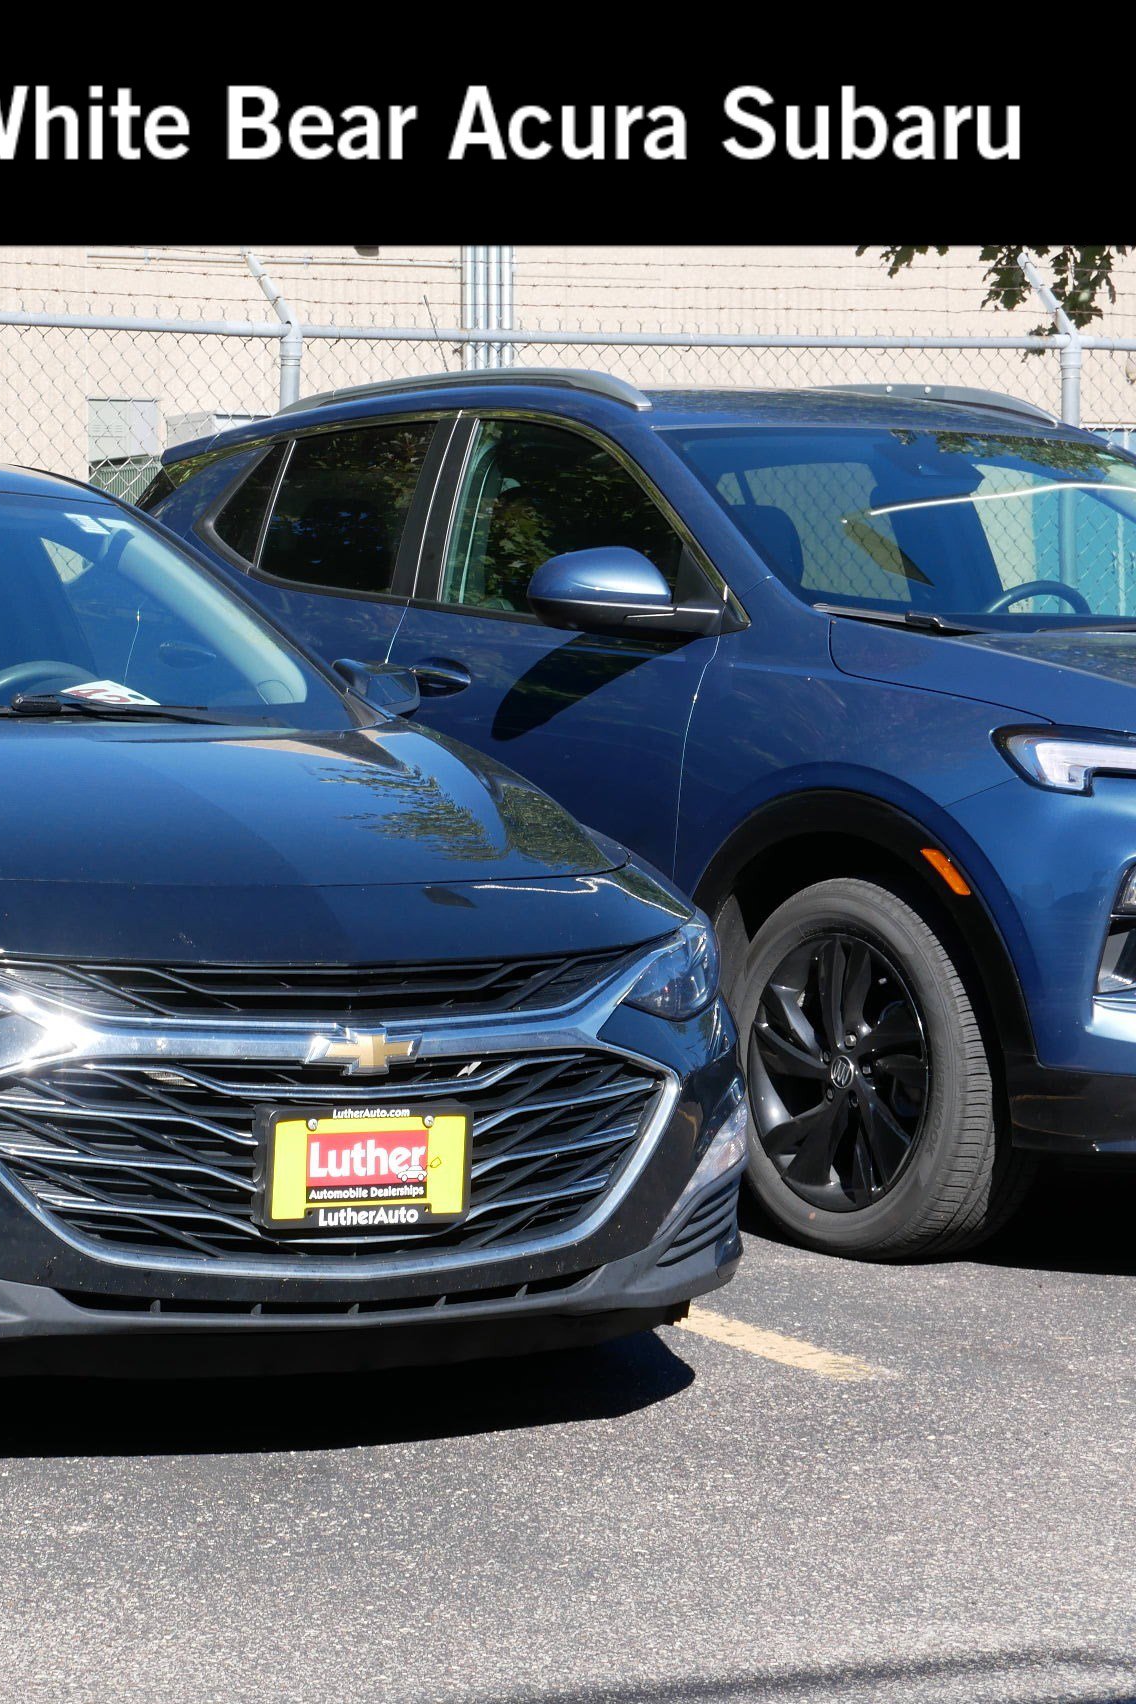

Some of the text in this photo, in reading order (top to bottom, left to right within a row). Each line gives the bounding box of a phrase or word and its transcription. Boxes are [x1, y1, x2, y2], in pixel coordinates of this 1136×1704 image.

[333, 1108, 410, 1119] LutherAuto.com
[309, 1139, 426, 1178] Luther
[309, 1185, 424, 1200] Automobile Dealerships
[318, 1207, 419, 1227] LutherAuto
